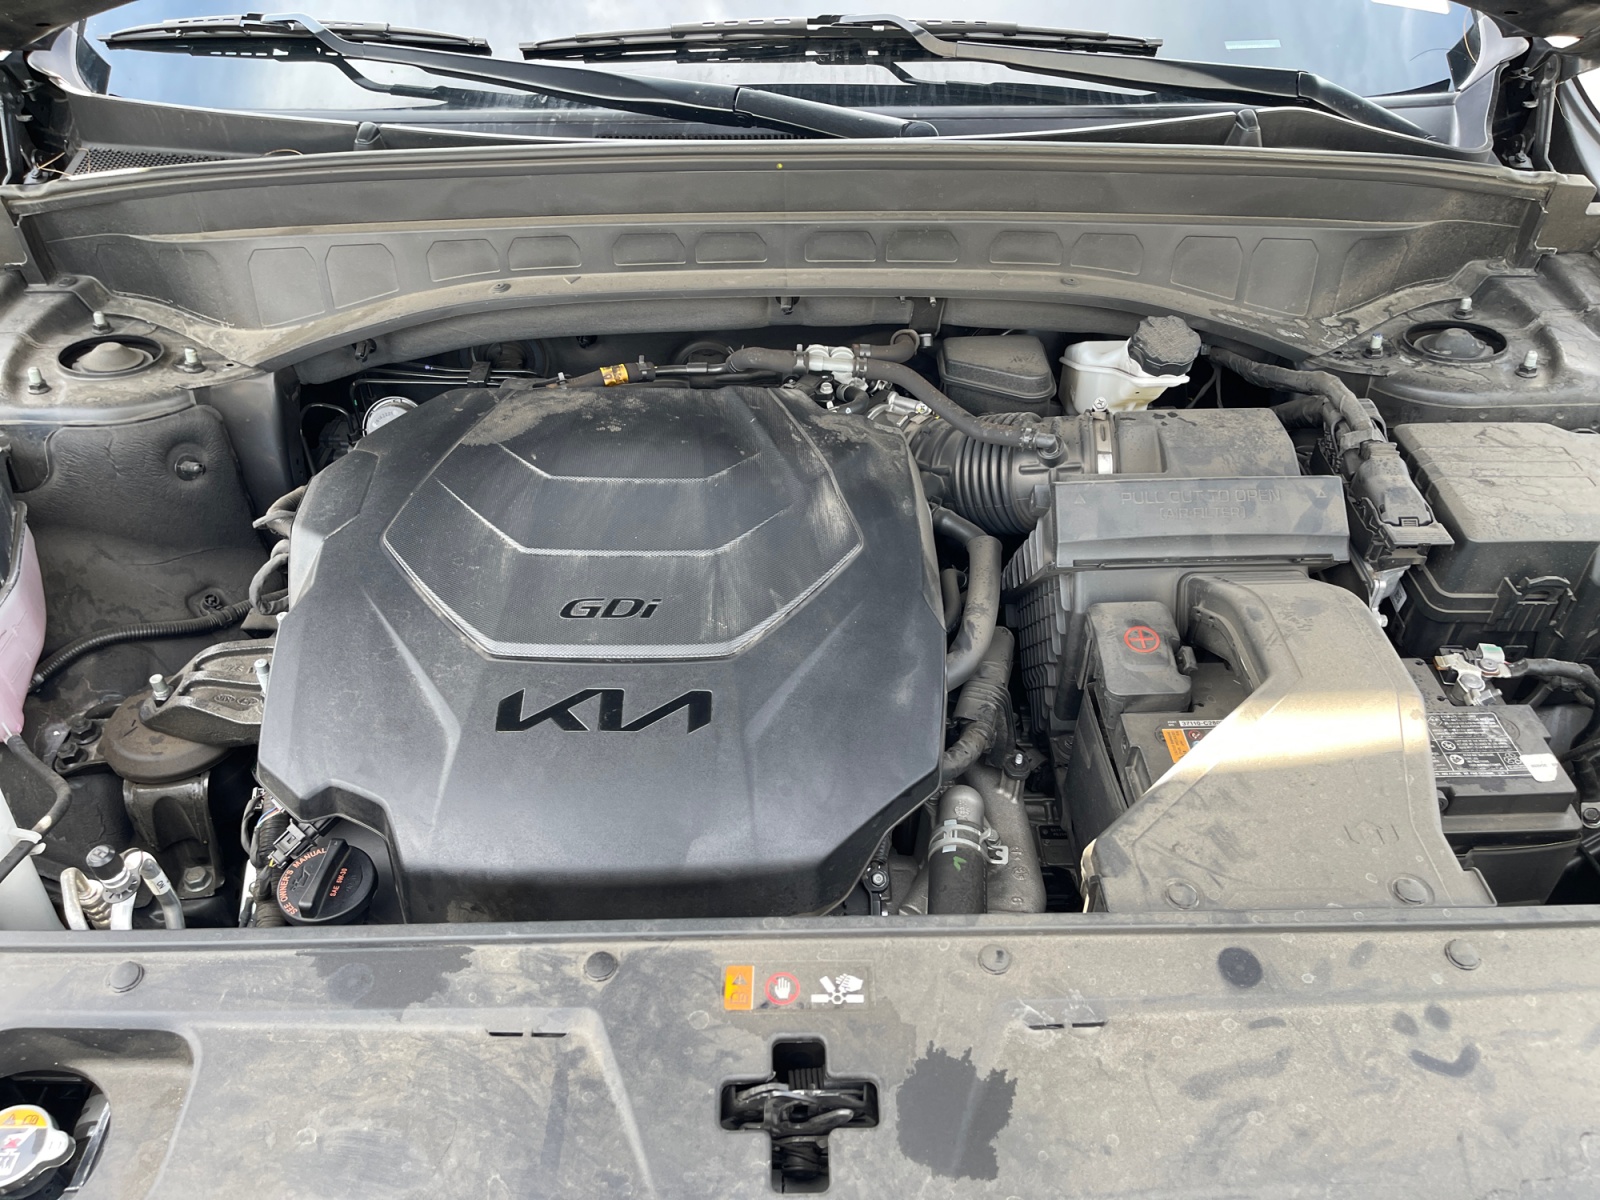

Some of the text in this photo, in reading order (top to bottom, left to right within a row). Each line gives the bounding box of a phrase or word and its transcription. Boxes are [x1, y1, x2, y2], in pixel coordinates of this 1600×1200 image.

[1120, 488, 1282, 505] PULL OUT TO OPEN
[559, 597, 664, 620] GDi
[495, 687, 713, 735] KIA
[278, 847, 327, 916] SEE OWNER'S MANUAL
[329, 885, 340, 898] SAE
